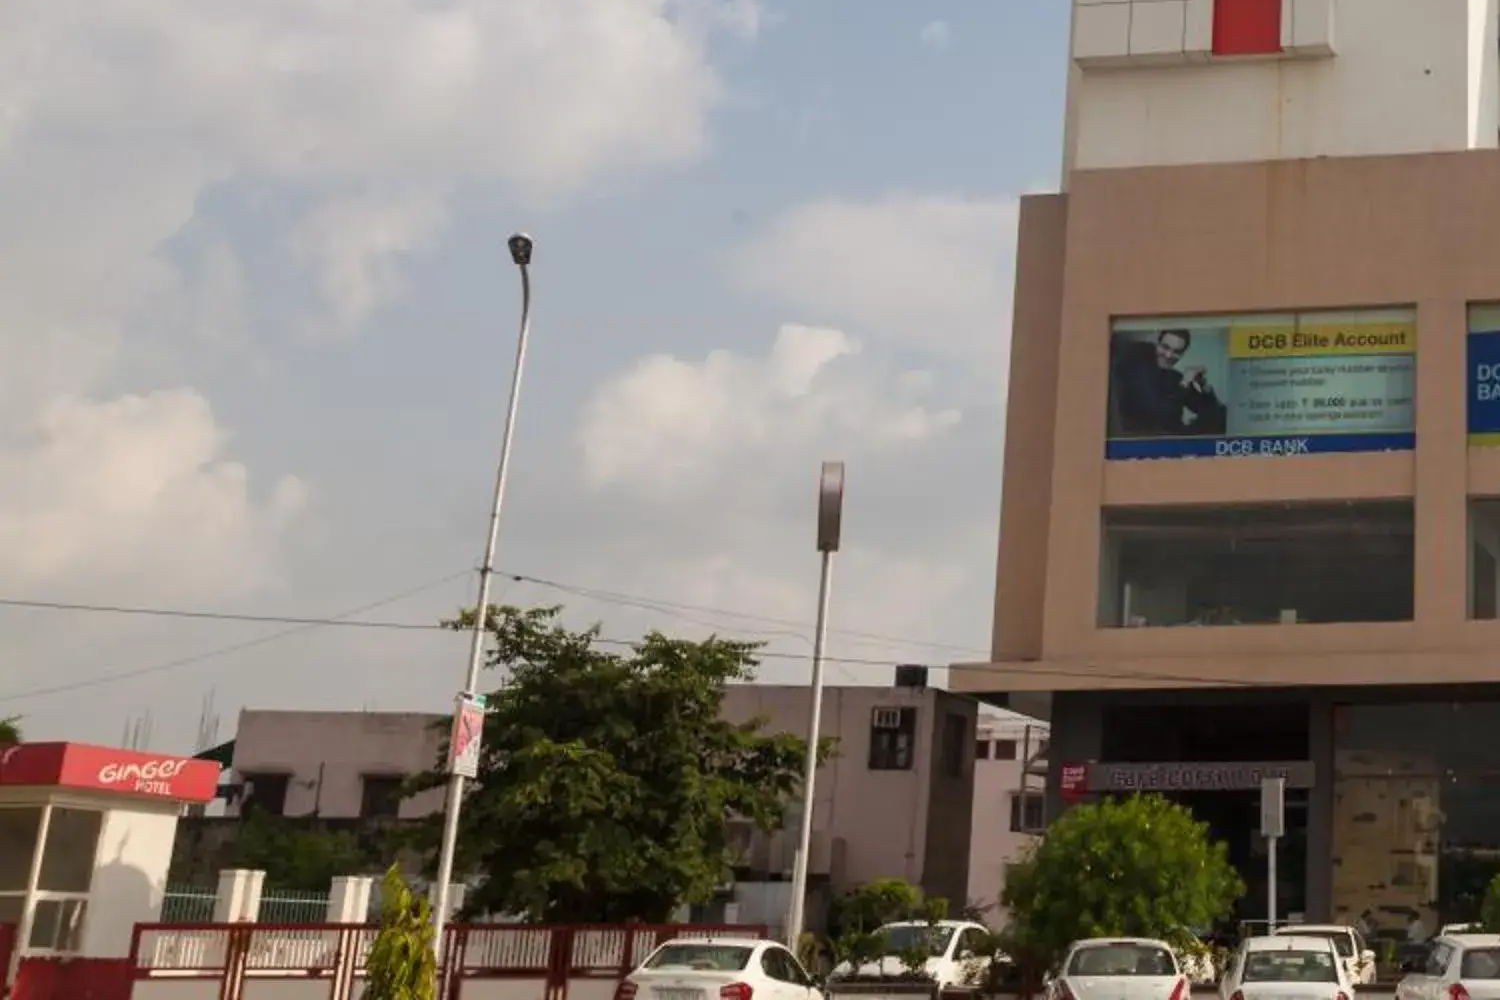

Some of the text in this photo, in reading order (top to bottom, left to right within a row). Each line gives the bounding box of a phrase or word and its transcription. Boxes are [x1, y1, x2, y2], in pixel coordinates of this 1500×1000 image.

[1248, 330, 1406, 350] DCB Elite Account
[1214, 437, 1309, 457] DCB BANK
[133, 780, 173, 796] HOTEL
